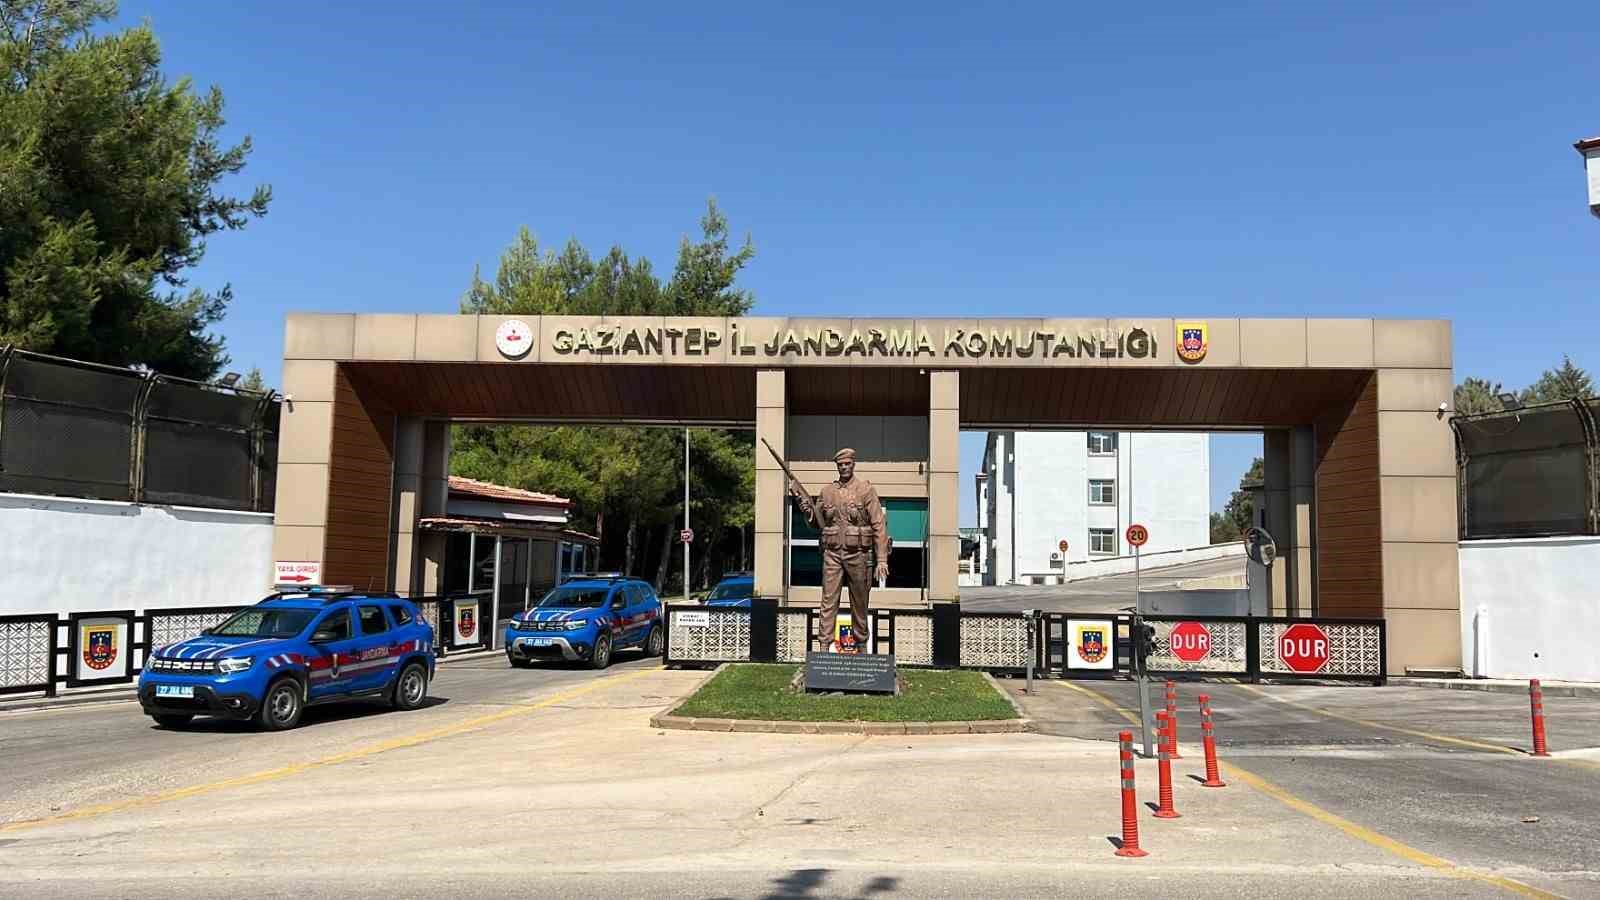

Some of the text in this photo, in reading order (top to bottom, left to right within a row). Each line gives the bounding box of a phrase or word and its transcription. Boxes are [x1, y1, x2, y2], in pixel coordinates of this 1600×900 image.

[552, 320, 722, 356] GAZİANTEP
[731, 322, 757, 356] İL
[764, 325, 936, 357] JANDARMA
[943, 325, 1158, 358] KOMUTANLIĞI
[1130, 530, 1144, 541] 20
[1172, 633, 1208, 650] DUR
[1282, 638, 1326, 658] DUR
[159, 686, 169, 695] 27
